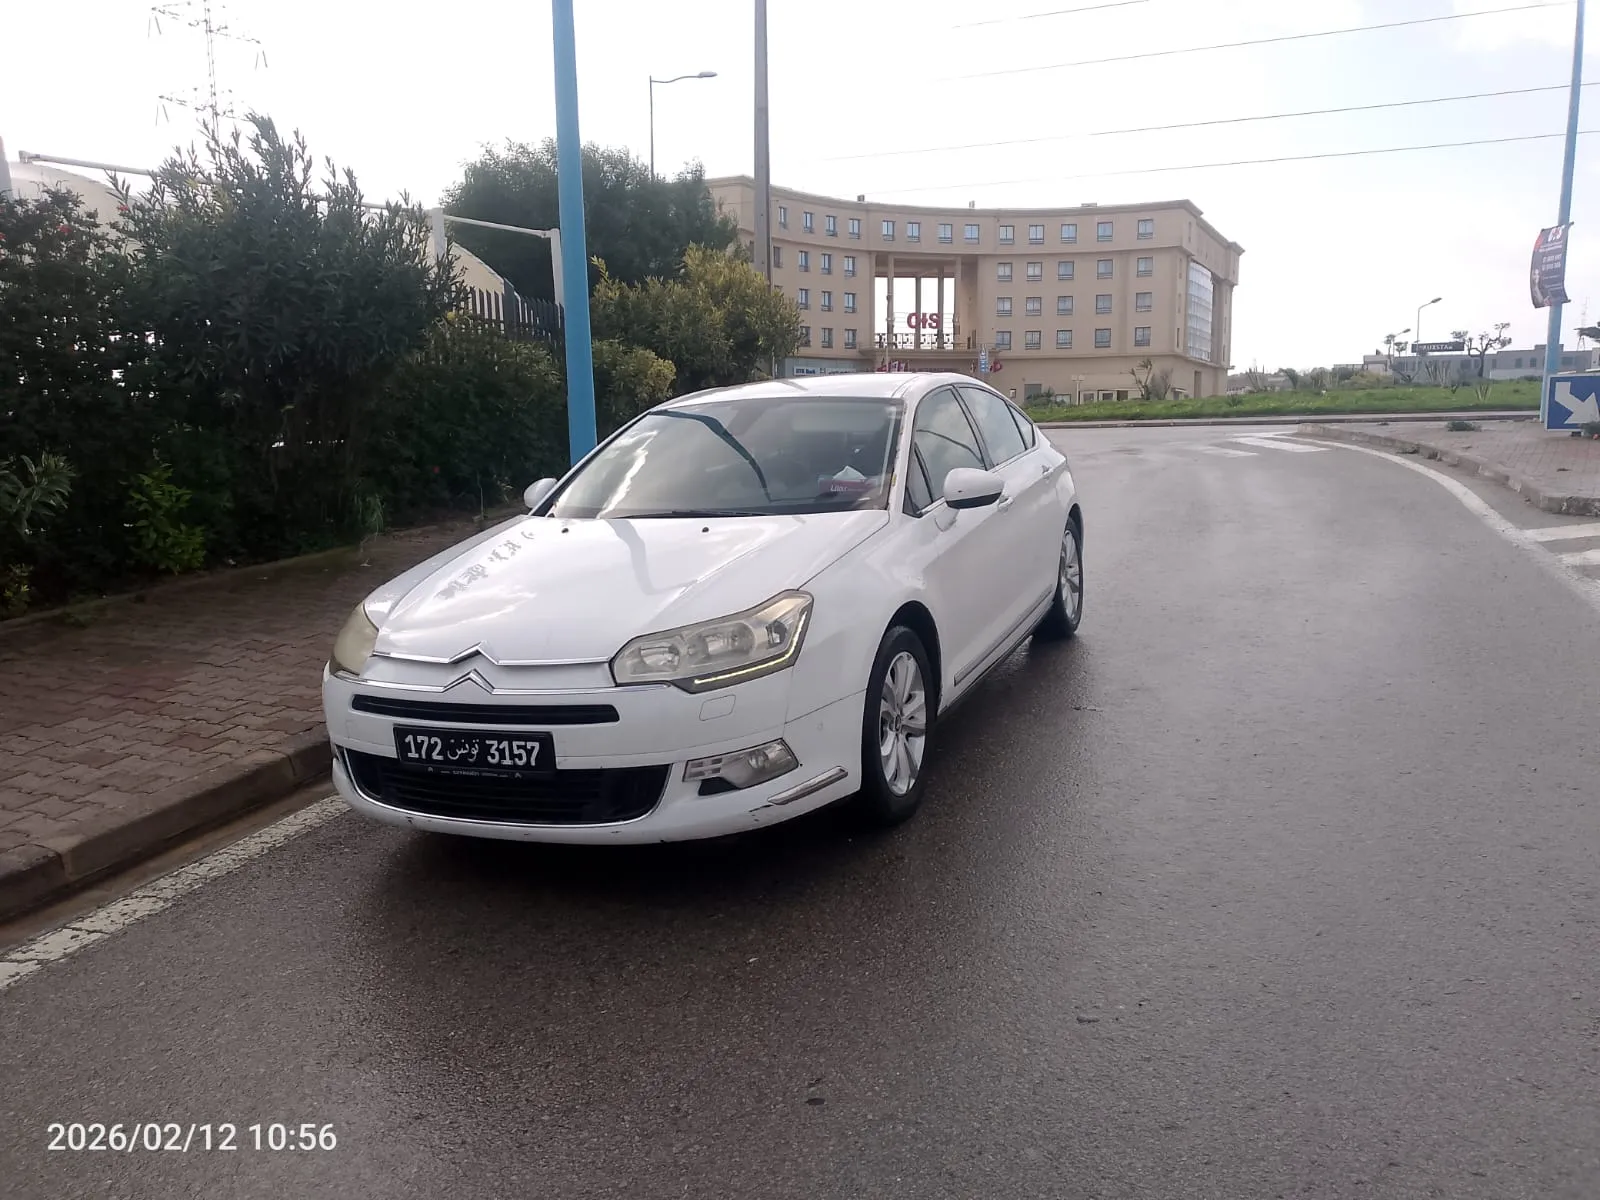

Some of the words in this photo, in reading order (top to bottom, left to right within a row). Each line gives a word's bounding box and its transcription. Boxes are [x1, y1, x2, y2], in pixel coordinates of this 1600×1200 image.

[404, 734, 444, 760] 172
[447, 738, 479, 762] تونس
[485, 739, 540, 766] 3157
